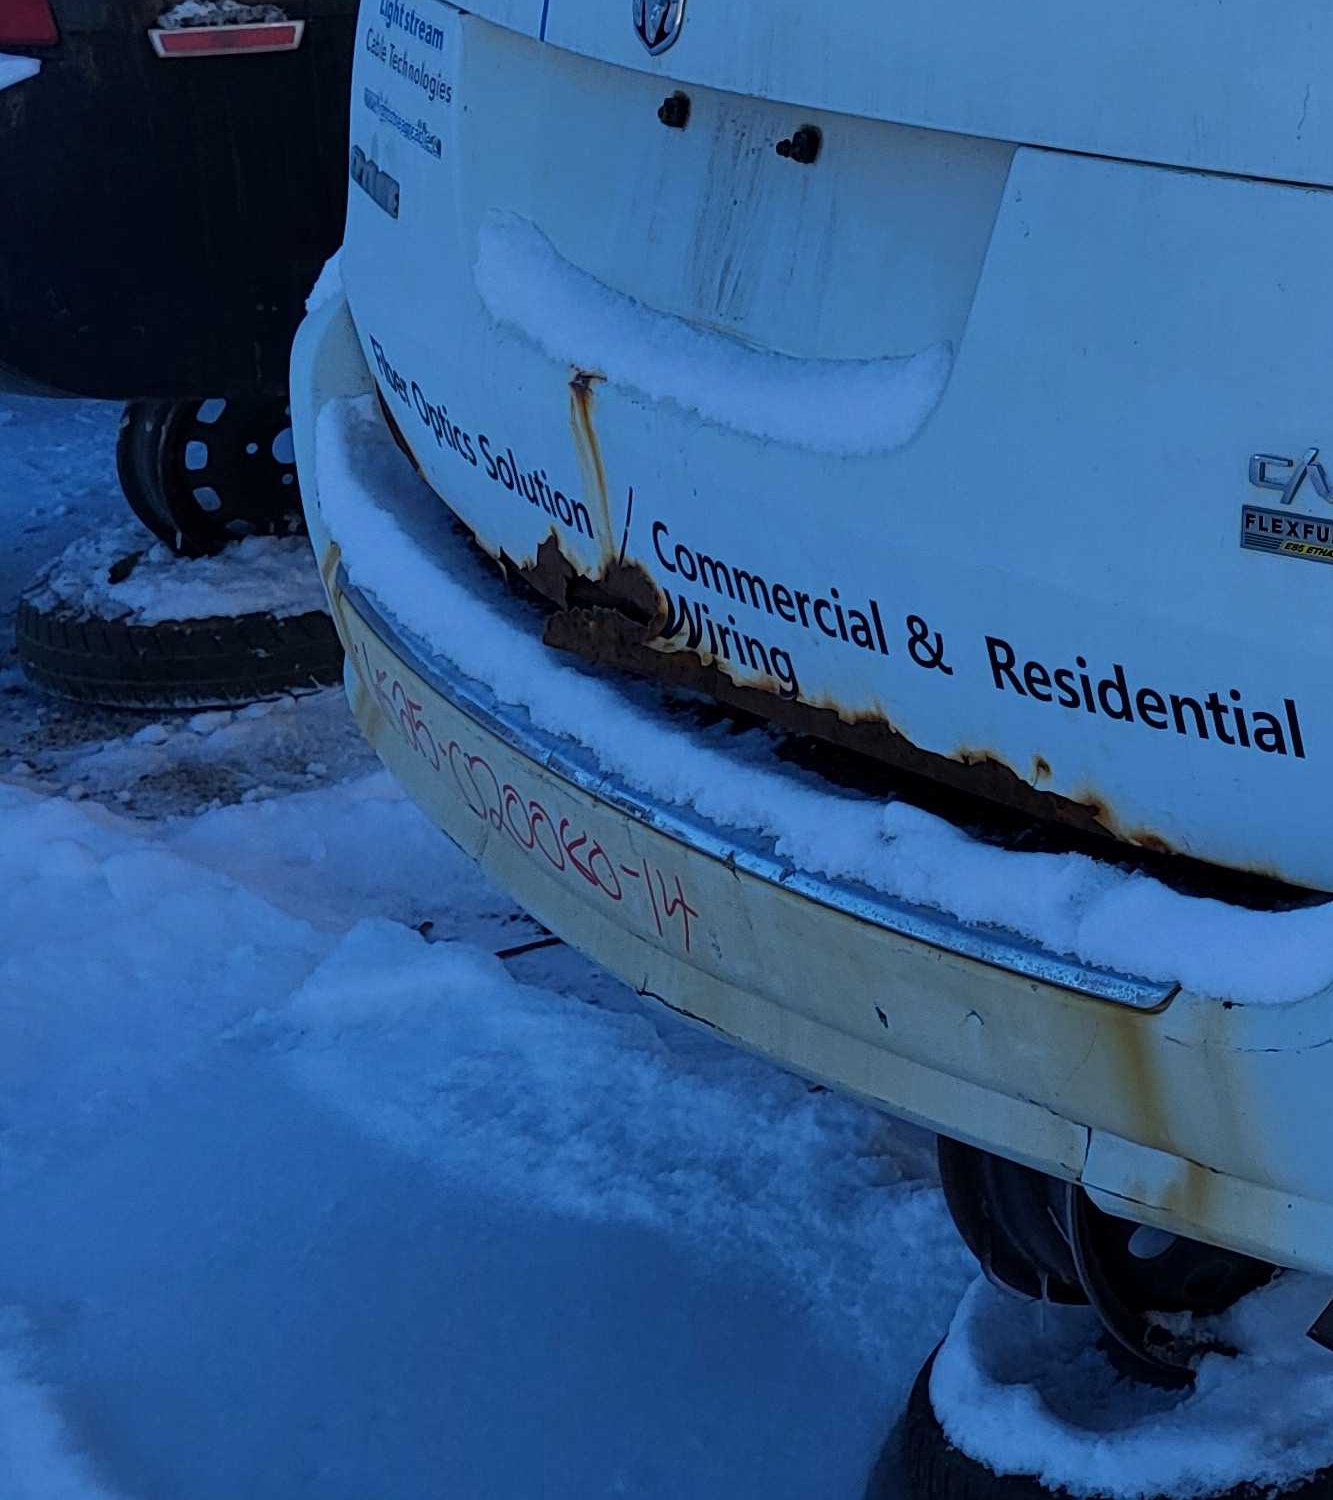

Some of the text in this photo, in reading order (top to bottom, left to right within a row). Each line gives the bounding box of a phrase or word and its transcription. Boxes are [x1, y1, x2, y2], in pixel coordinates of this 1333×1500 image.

[366, 27, 452, 104] Cable Technologies
[369, 333, 594, 539] Fiber Optics Solution
[1284, 542, 1305, 553] E85
[652, 520, 1307, 759] Commercial & Residential
[664, 587, 799, 700] Wiring
